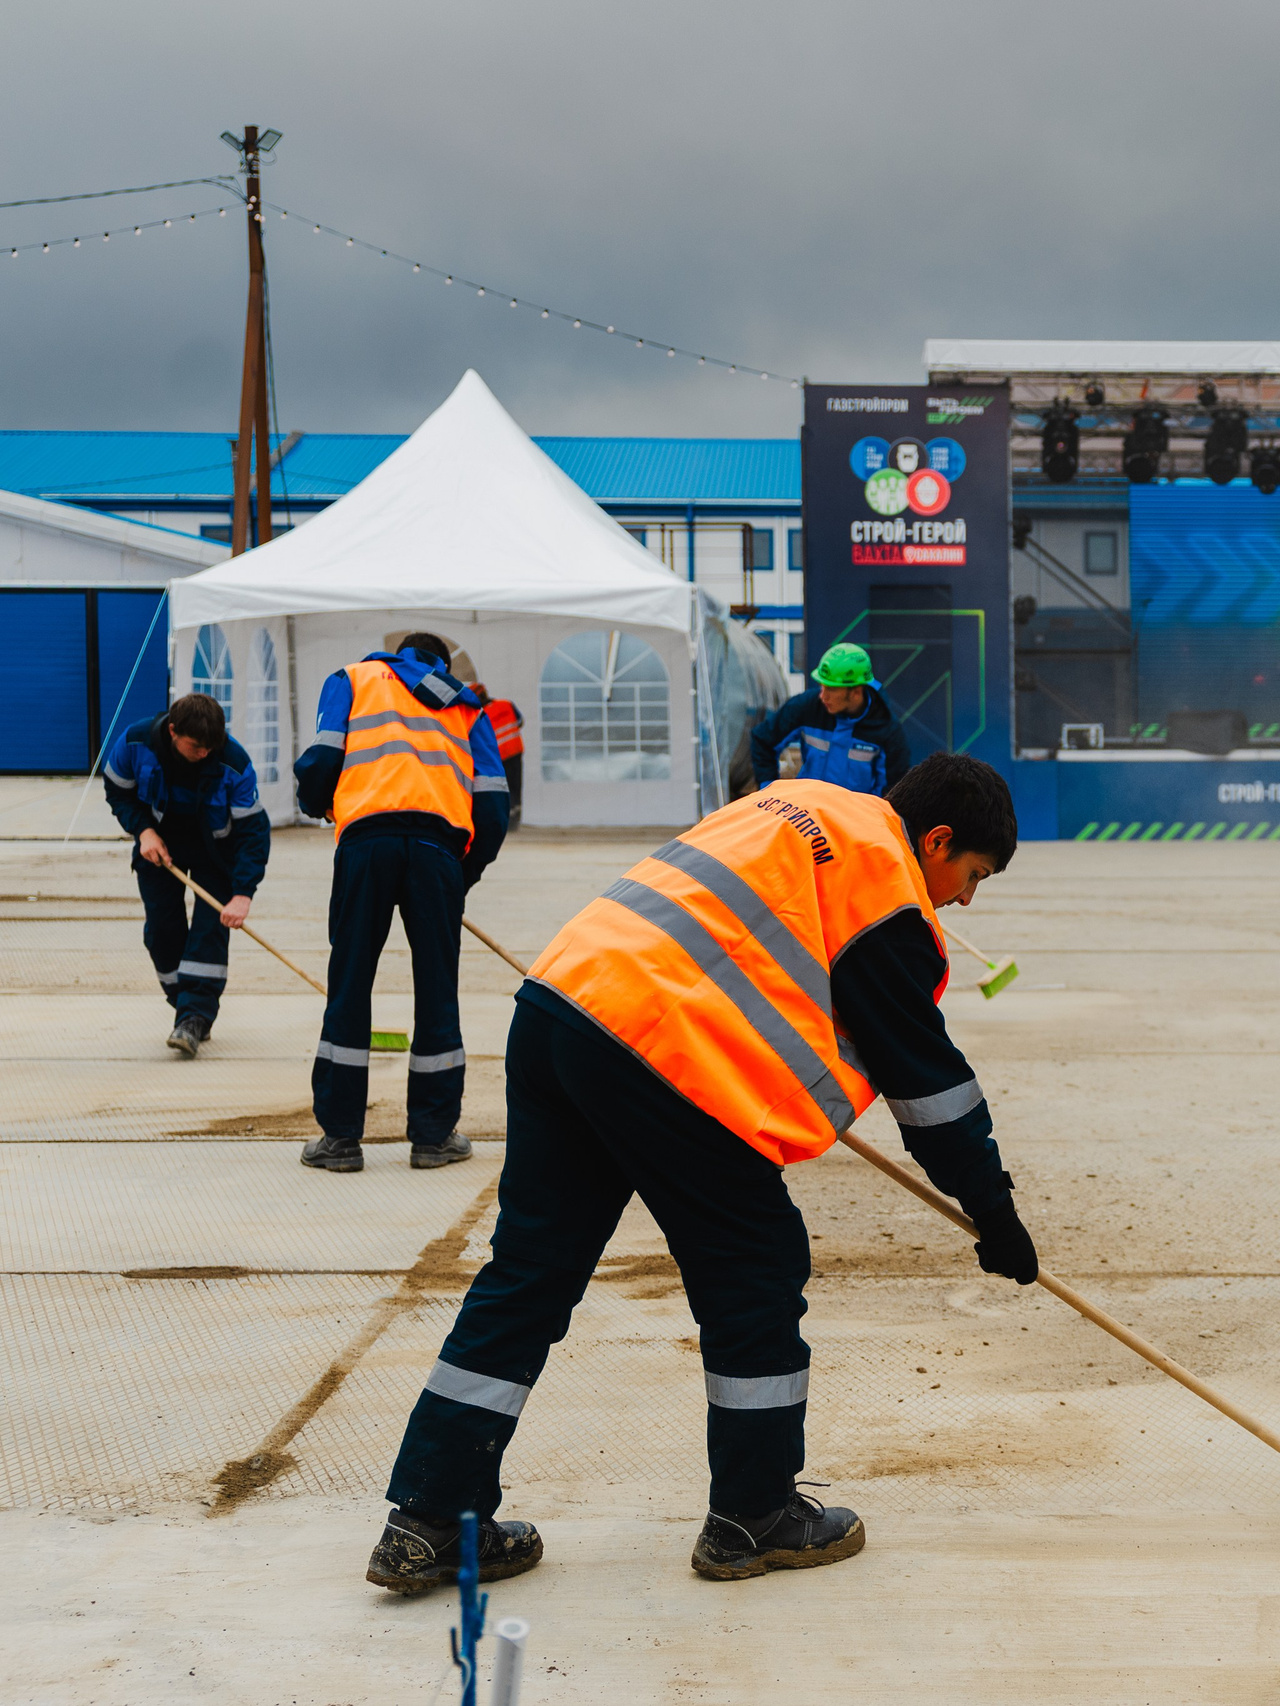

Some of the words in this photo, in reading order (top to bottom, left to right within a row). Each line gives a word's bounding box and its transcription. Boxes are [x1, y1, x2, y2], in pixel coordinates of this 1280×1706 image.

[826, 396, 909, 413] ГАЗСТРОЙПРОМ
[851, 518, 967, 544] СТРОЙ-ГЕРОЙ
[852, 544, 902, 564] ВАХТА
